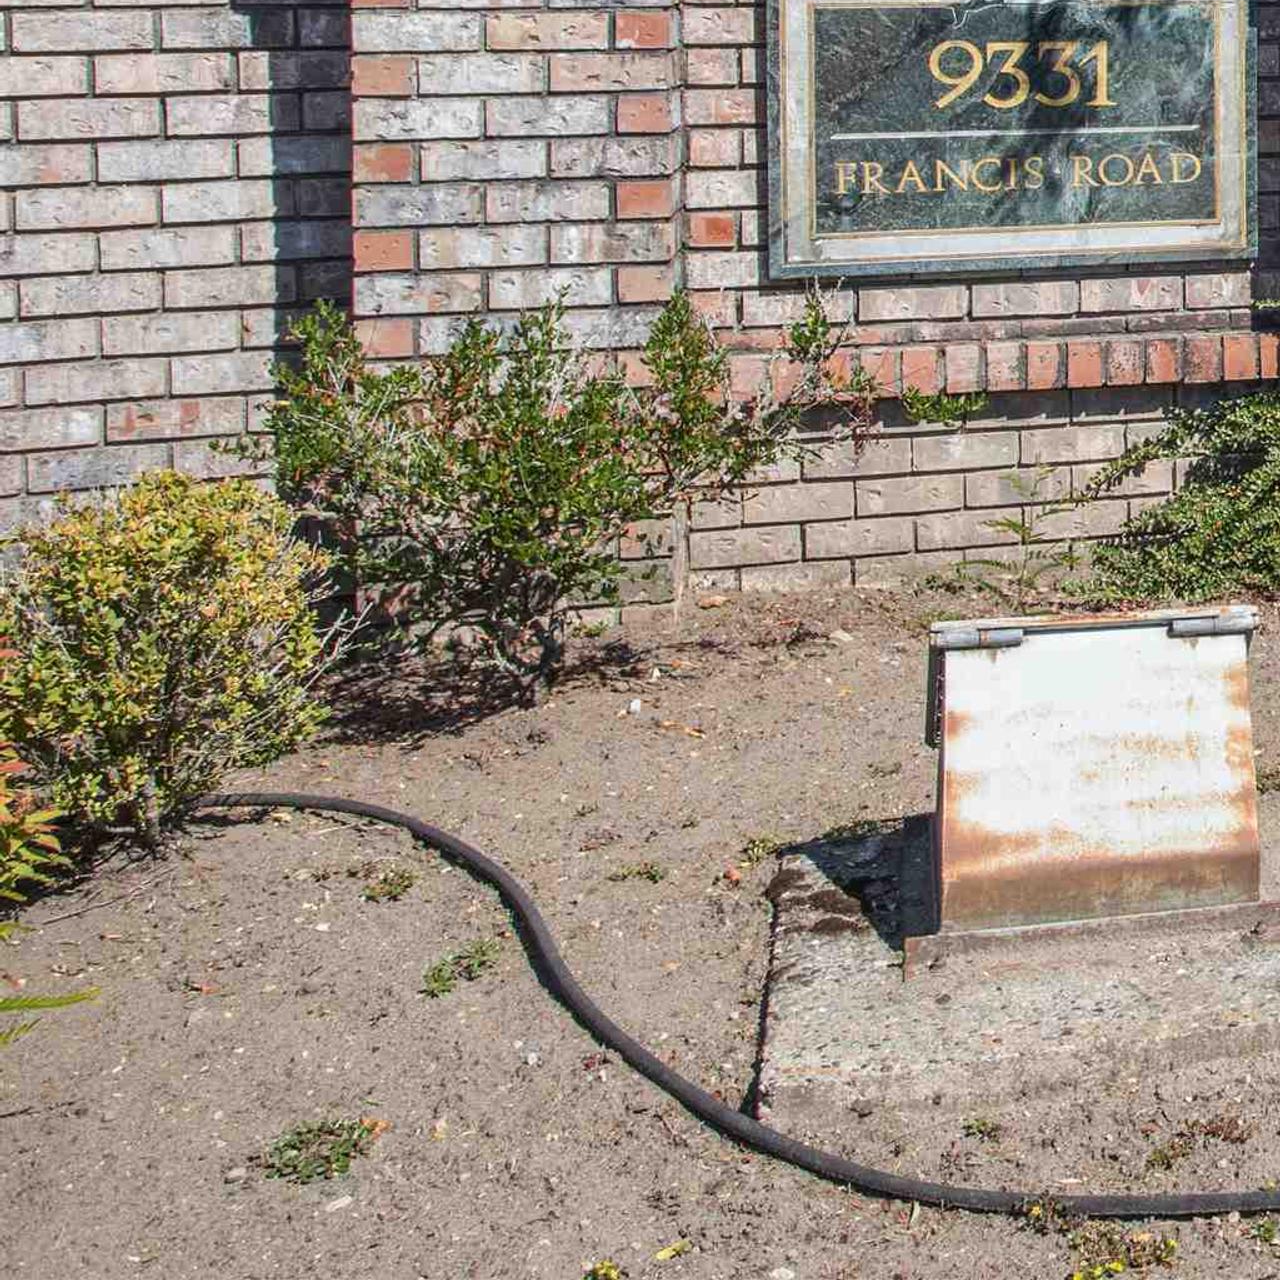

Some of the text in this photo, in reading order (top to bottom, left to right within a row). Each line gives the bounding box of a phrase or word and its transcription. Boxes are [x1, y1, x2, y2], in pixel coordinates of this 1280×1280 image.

[928, 39, 1118, 111] 9331
[835, 151, 1201, 195] FRANCIS ROAD
